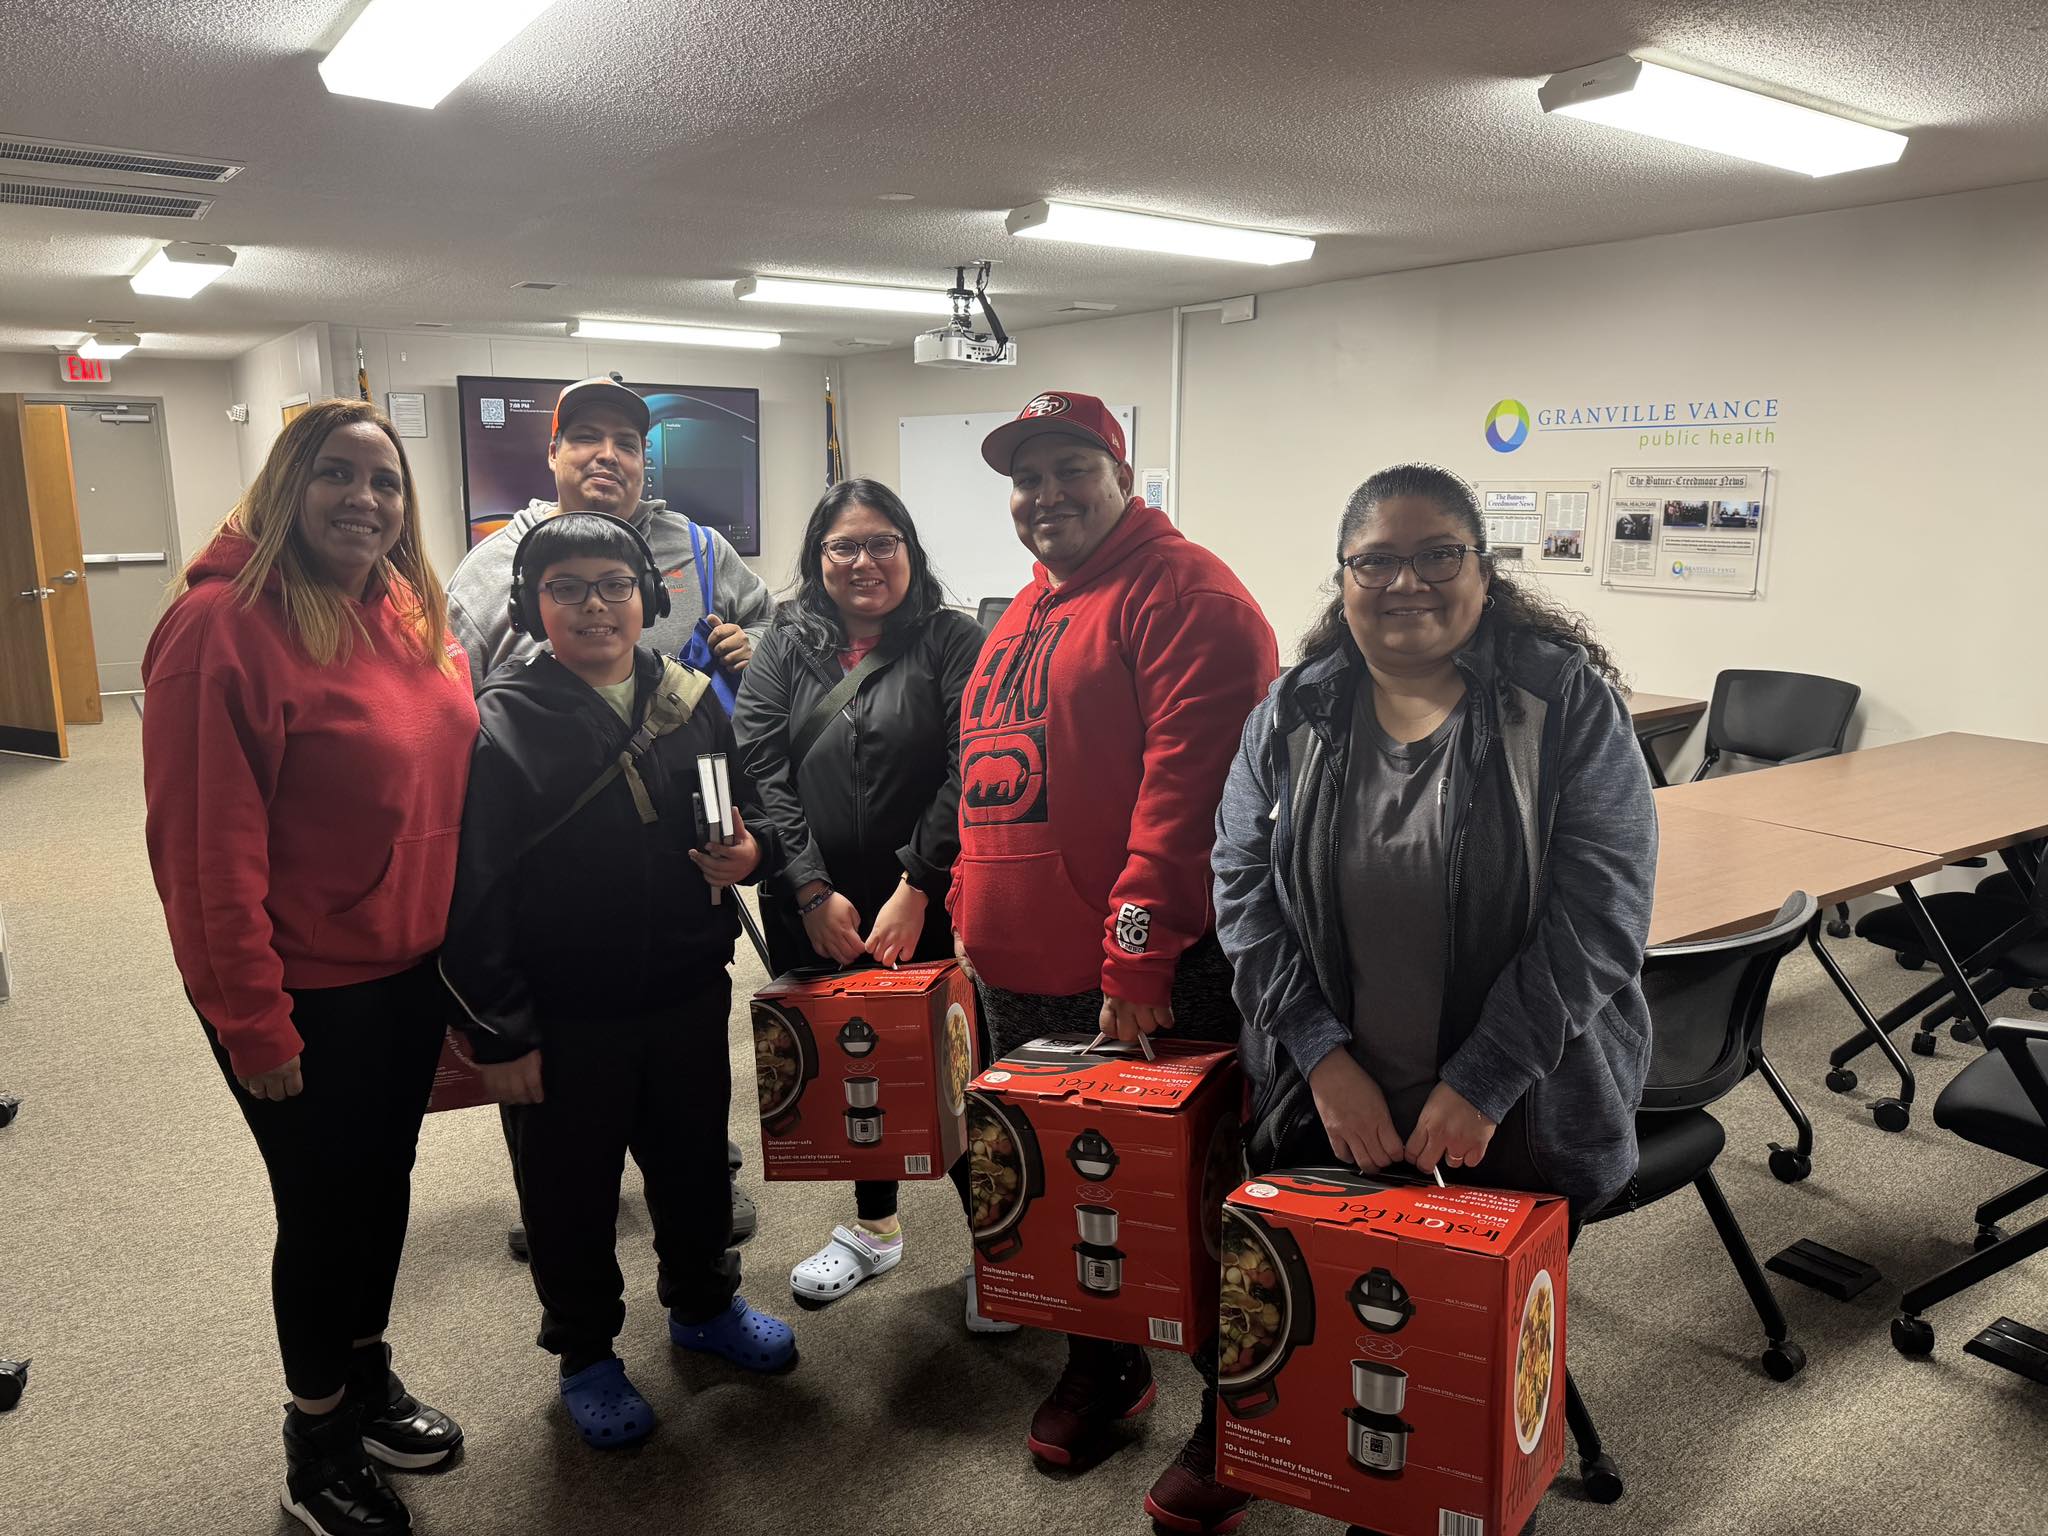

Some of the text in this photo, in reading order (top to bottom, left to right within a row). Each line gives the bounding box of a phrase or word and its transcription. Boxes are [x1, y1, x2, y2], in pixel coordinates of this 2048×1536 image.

[1538, 399, 1778, 426] GRANVILLE VANCE
[1640, 427, 1775, 450] public health
[1629, 476, 1643, 486] The
[1720, 476, 1744, 486] News
[963, 616, 1070, 731] ECKO
[1119, 1073, 1192, 1084] MULTI-COOKER
[1099, 1082, 1183, 1100] Instant
[1427, 1193, 1516, 1213] Delicious one-pot
[1459, 1194, 1519, 1208] meals made
[1414, 1202, 1509, 1224] MULTI-COOKER
[1394, 1212, 1501, 1242] Instant
[982, 1266, 1034, 1280] Dishwasher-safe
[994, 1286, 1018, 1296] built-in
[1020, 1290, 1039, 1300] safety
[1040, 1294, 1068, 1305] features
[1226, 1420, 1292, 1446] Dishwasher-safe
[1224, 1442, 1332, 1480] 10+ built-in safety features
